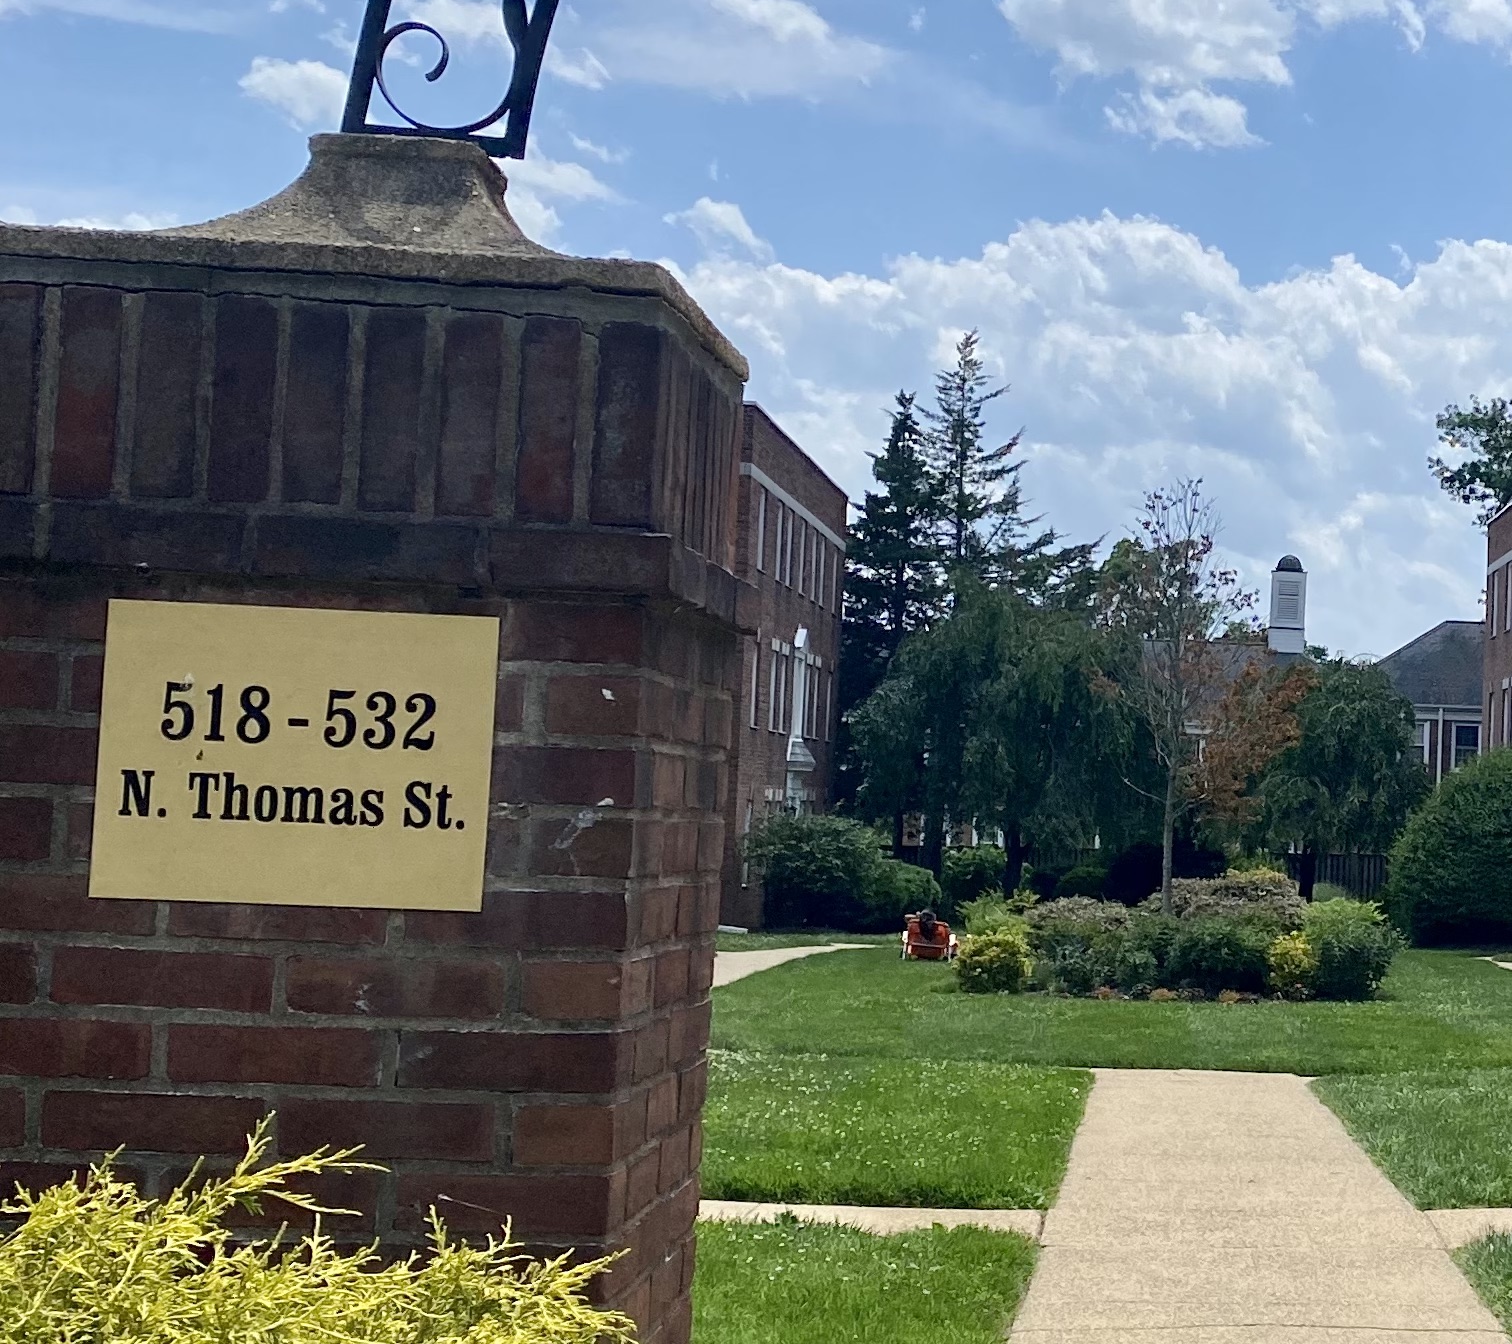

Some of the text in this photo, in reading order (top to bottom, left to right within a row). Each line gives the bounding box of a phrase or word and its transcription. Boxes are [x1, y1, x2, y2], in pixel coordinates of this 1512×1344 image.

[117, 769, 466, 830] N. Thomas St.
